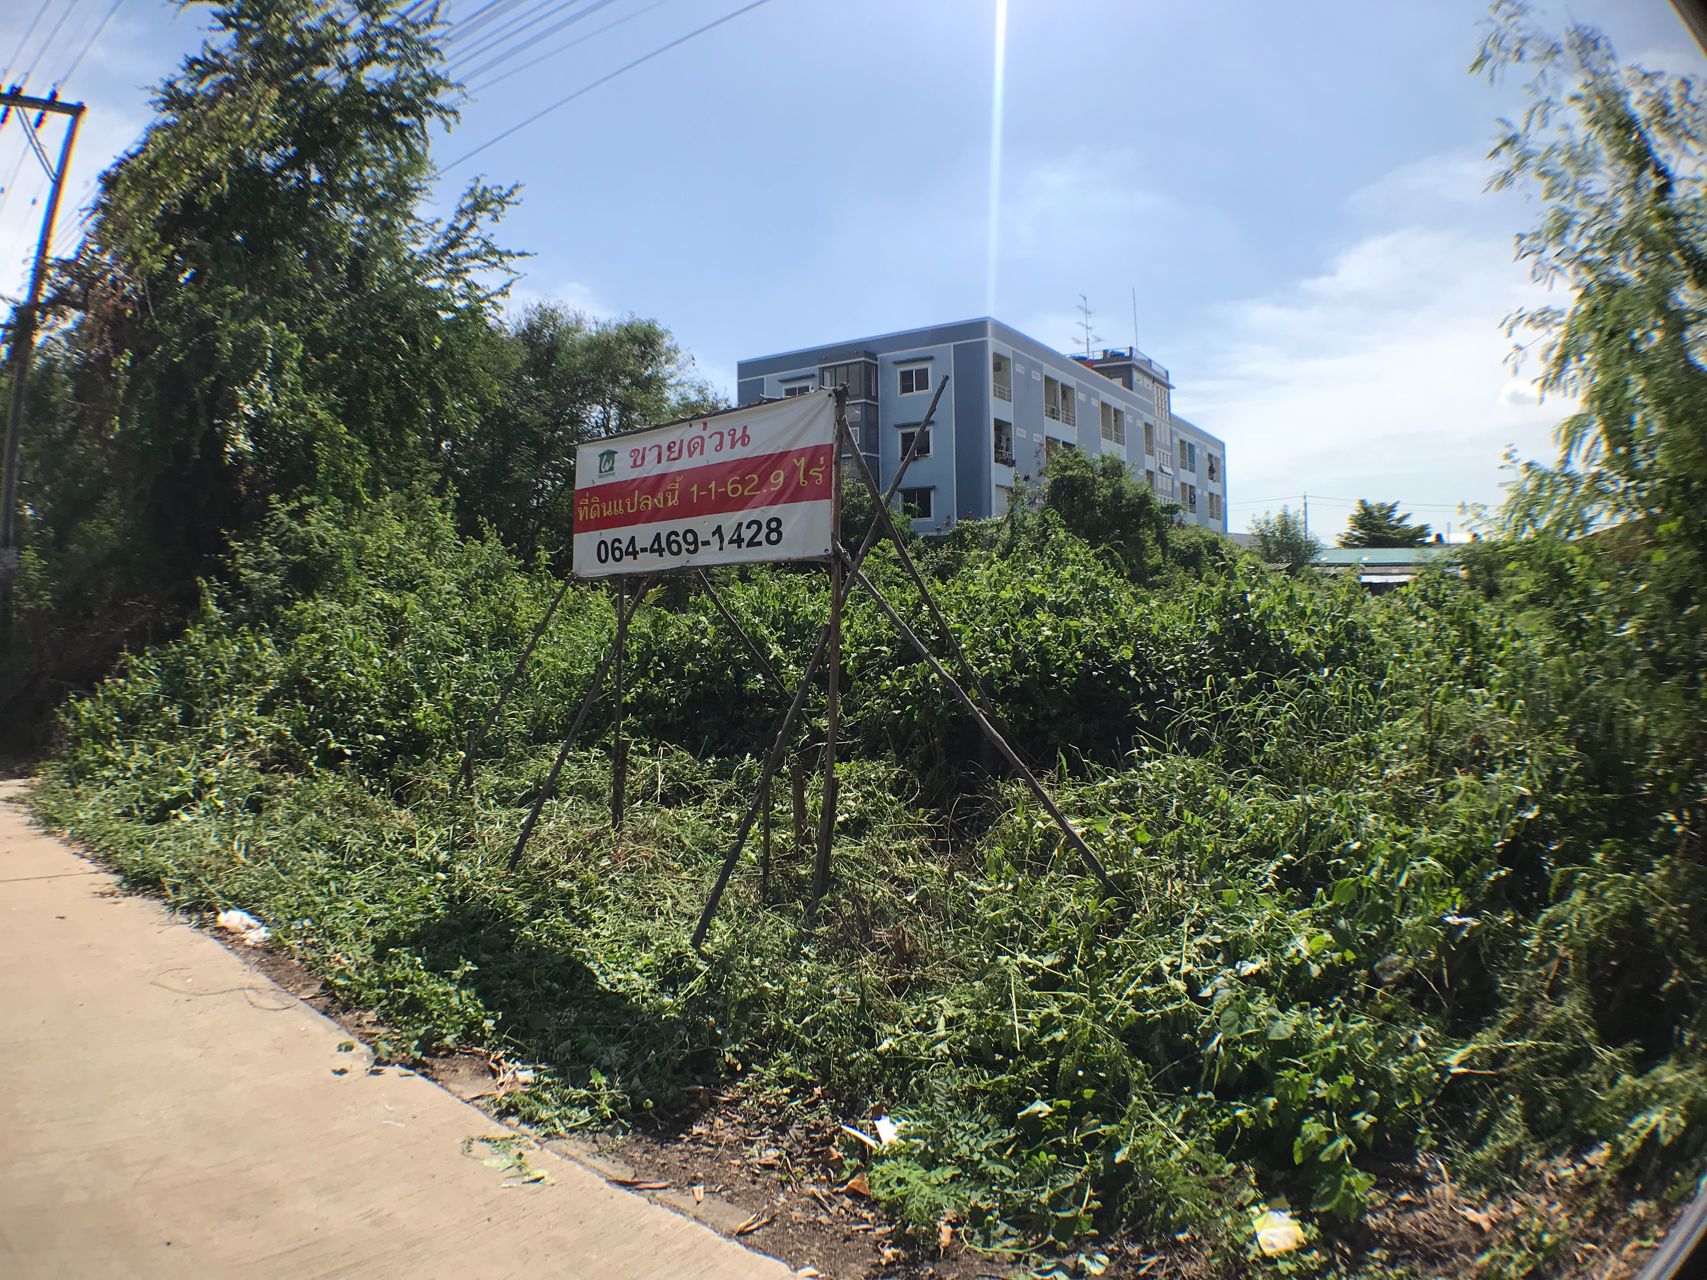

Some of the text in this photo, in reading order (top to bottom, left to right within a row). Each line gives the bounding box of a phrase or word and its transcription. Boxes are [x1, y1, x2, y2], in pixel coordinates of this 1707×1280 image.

[629, 421, 751, 469] ขายด่วน
[577, 456, 826, 521] ที่ดินแปลงนี้ 1-1-62.9 ไร่
[596, 517, 783, 564] 064-469-1428
